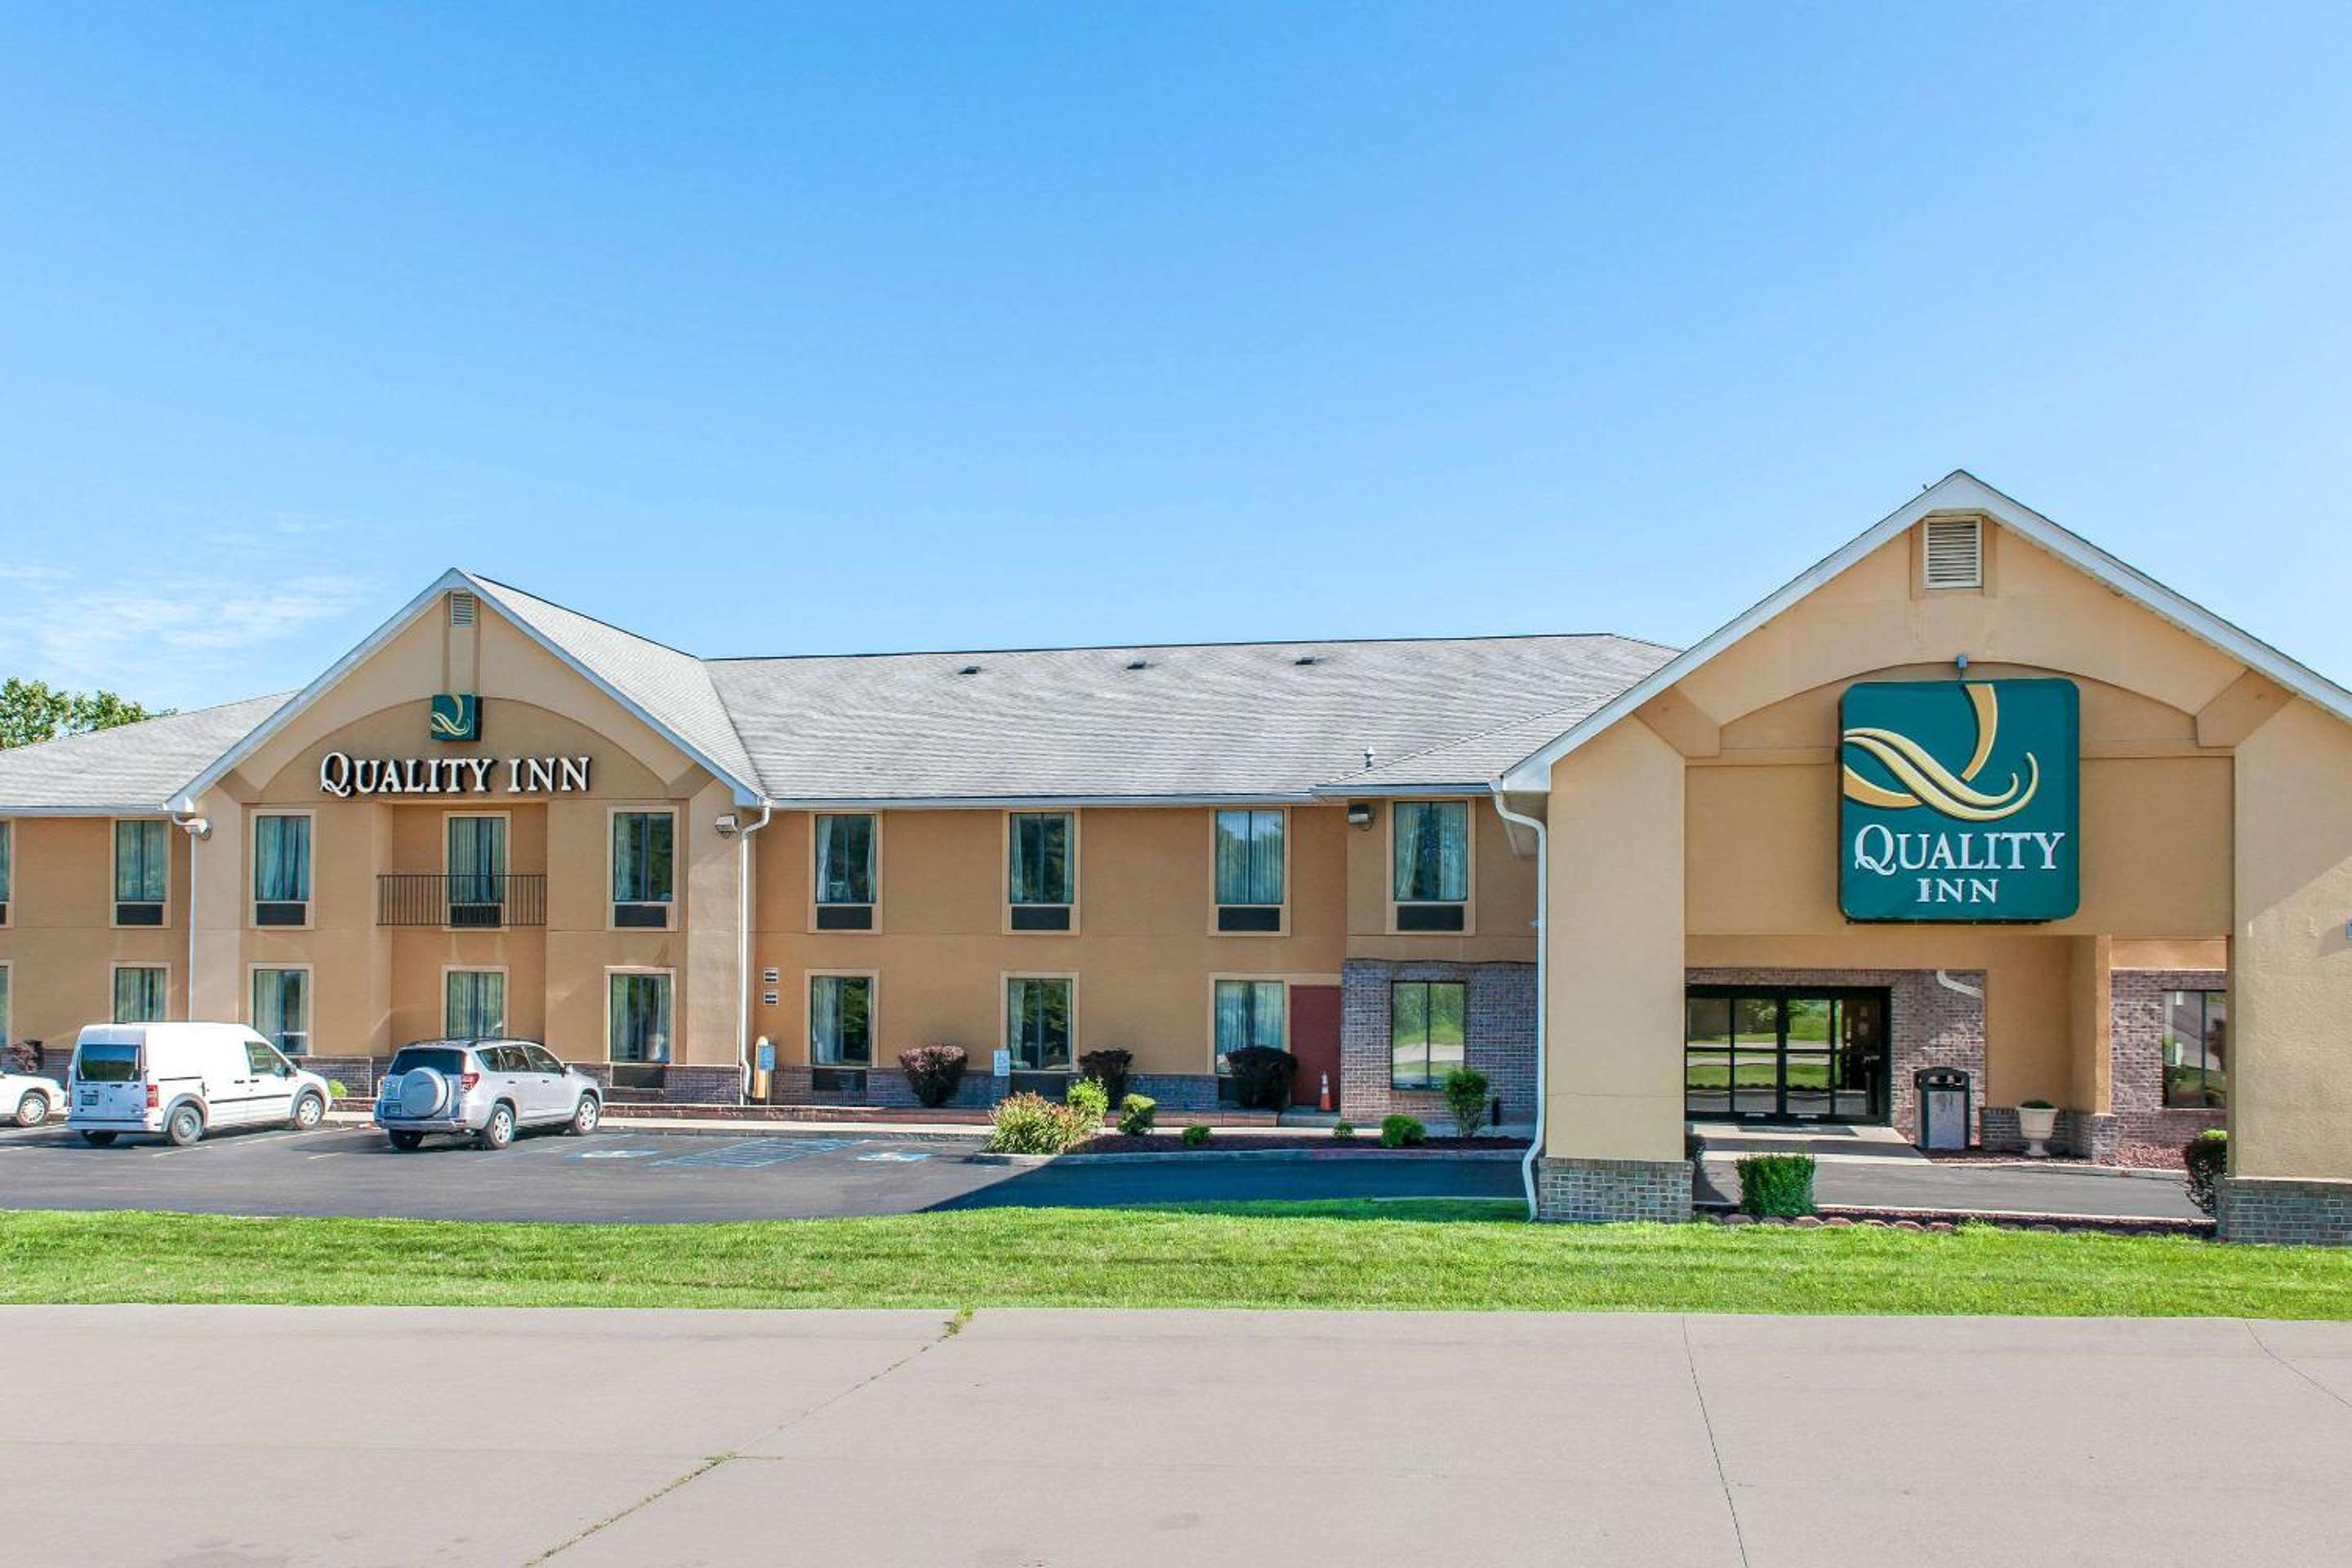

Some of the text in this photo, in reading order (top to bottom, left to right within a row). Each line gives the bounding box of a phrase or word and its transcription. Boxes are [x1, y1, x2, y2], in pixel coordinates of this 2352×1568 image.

[320, 752, 591, 797] QUALITY INN
[1855, 824, 2065, 875] QUALITY
[1917, 878, 1998, 903] INN
